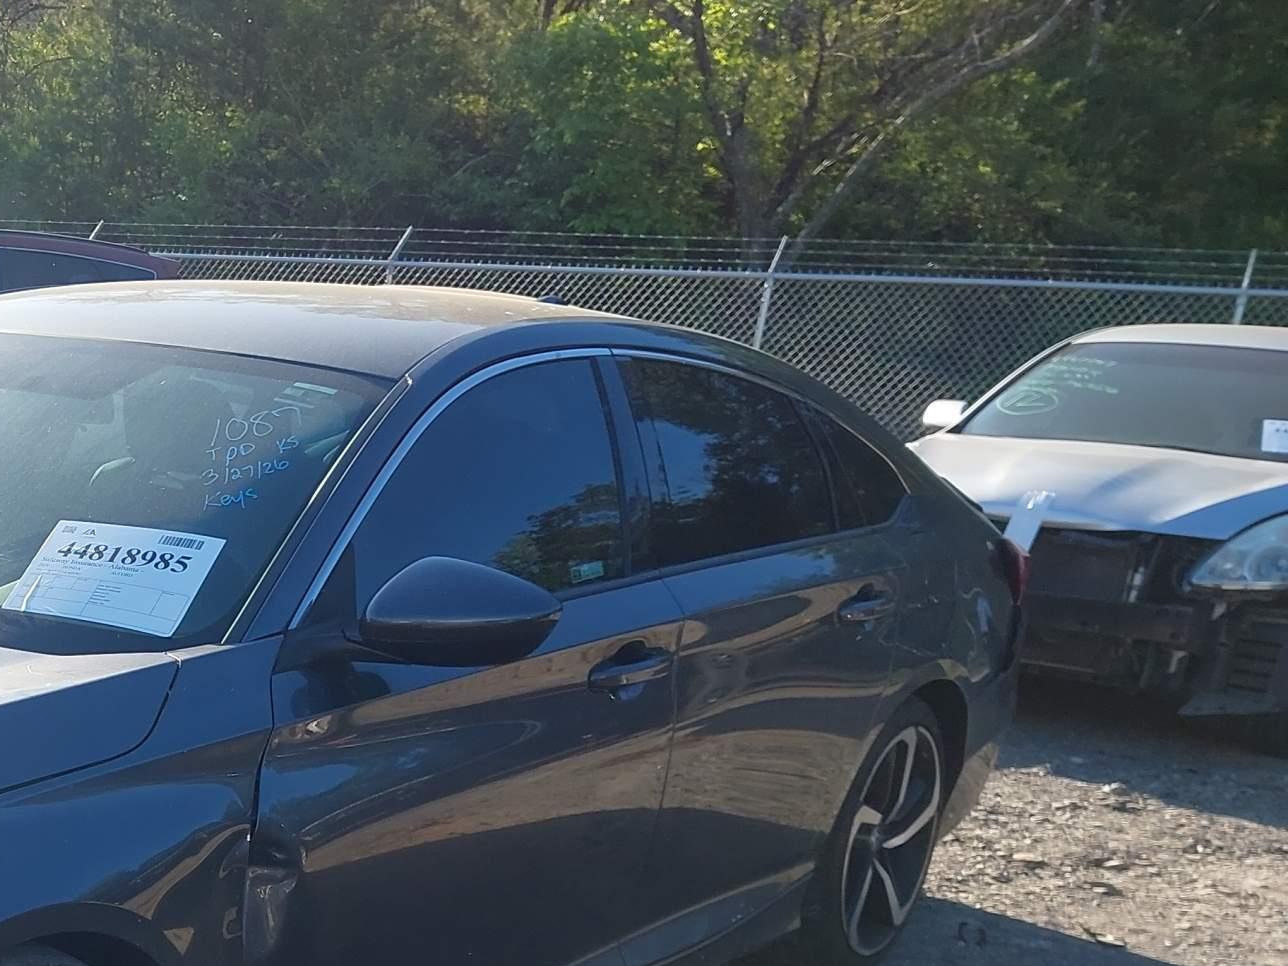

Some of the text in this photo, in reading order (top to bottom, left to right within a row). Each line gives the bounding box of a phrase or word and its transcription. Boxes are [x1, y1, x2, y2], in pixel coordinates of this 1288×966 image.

[210, 406, 302, 446] 1087
[200, 458, 290, 486] 3/27/26
[57, 541, 193, 574] 44818985
